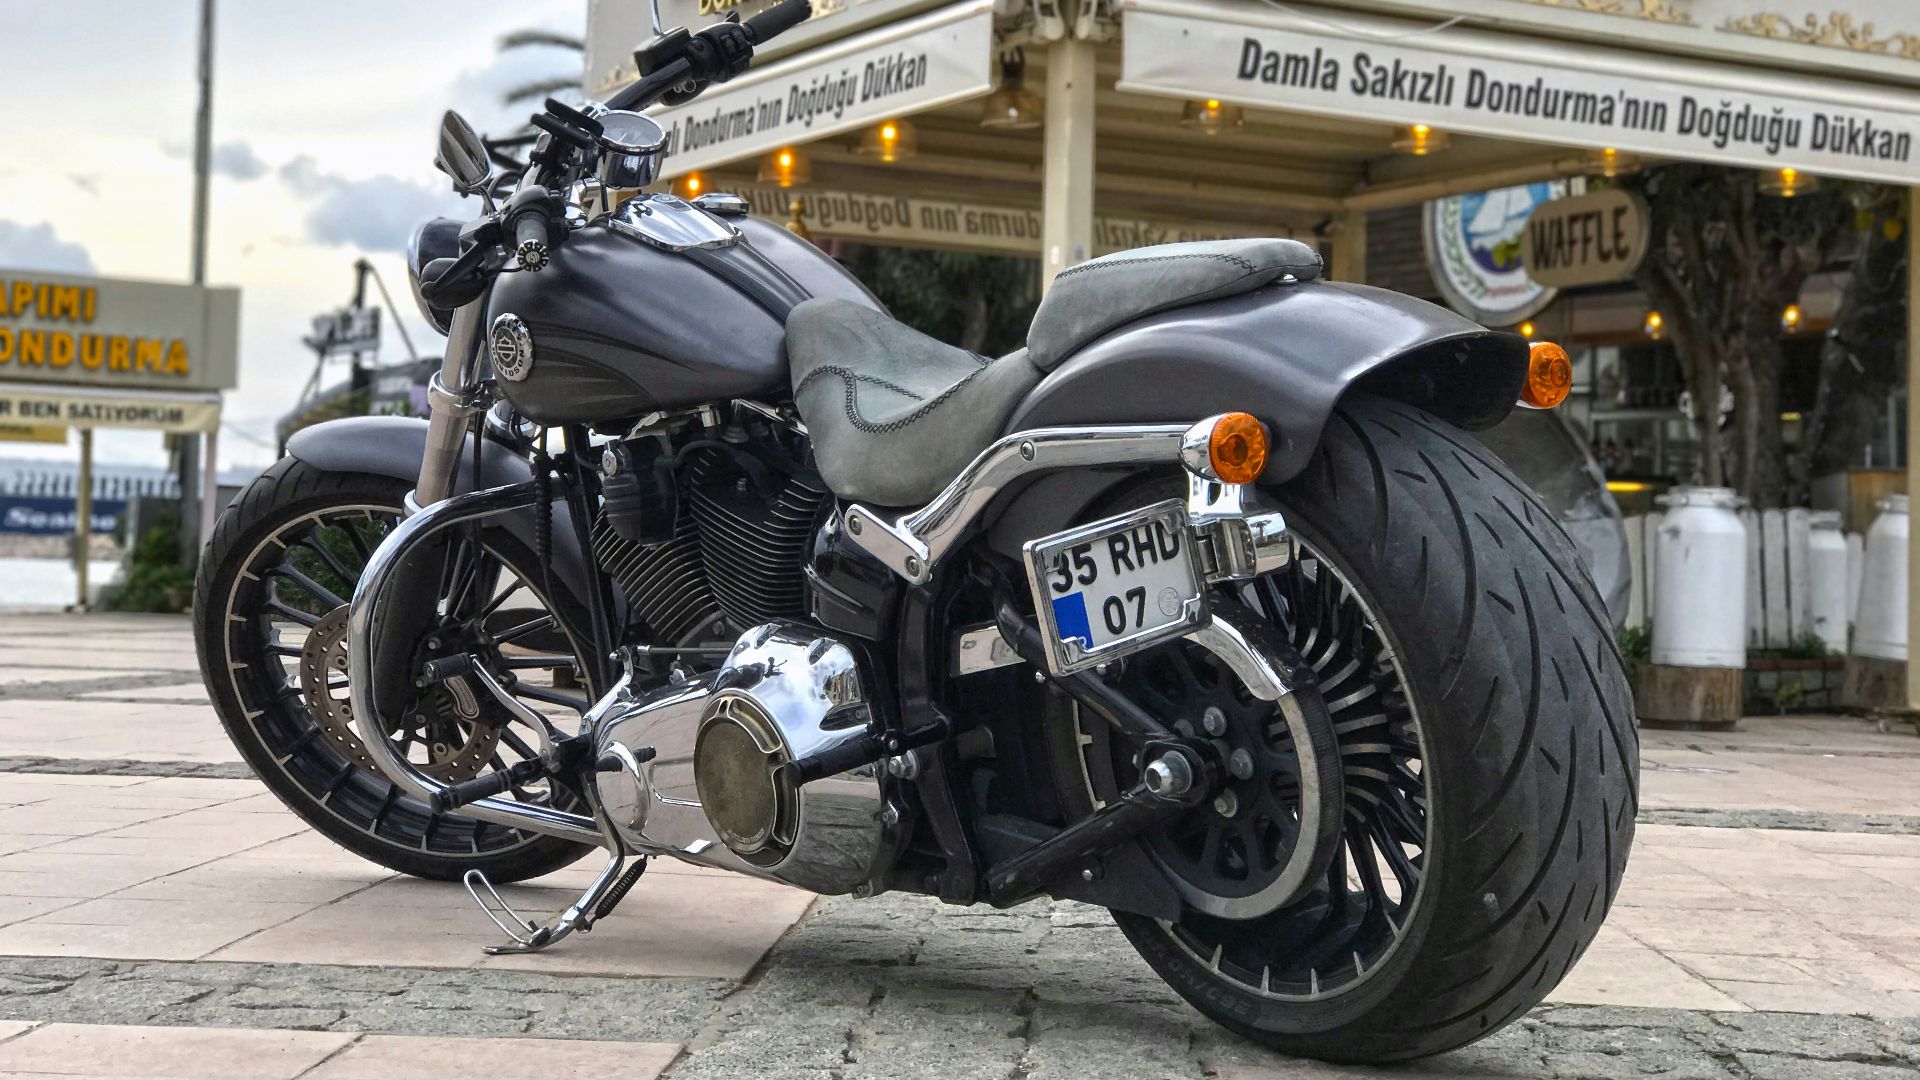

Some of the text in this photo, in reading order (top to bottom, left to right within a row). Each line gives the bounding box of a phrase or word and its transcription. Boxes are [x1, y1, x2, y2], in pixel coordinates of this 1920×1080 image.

[683, 97, 782, 152] Dondurma'nın
[786, 68, 858, 128] Doğduğu
[860, 52, 928, 102] Dükkan
[1237, 37, 1912, 162] Damla Sakızlı Dondurma'nın Doğduğu Dükkan
[1531, 205, 1629, 271] WAFFLE
[20, 401, 59, 418] BEN
[1052, 522, 1180, 592] 35 RHD
[1104, 586, 1146, 635] 07
